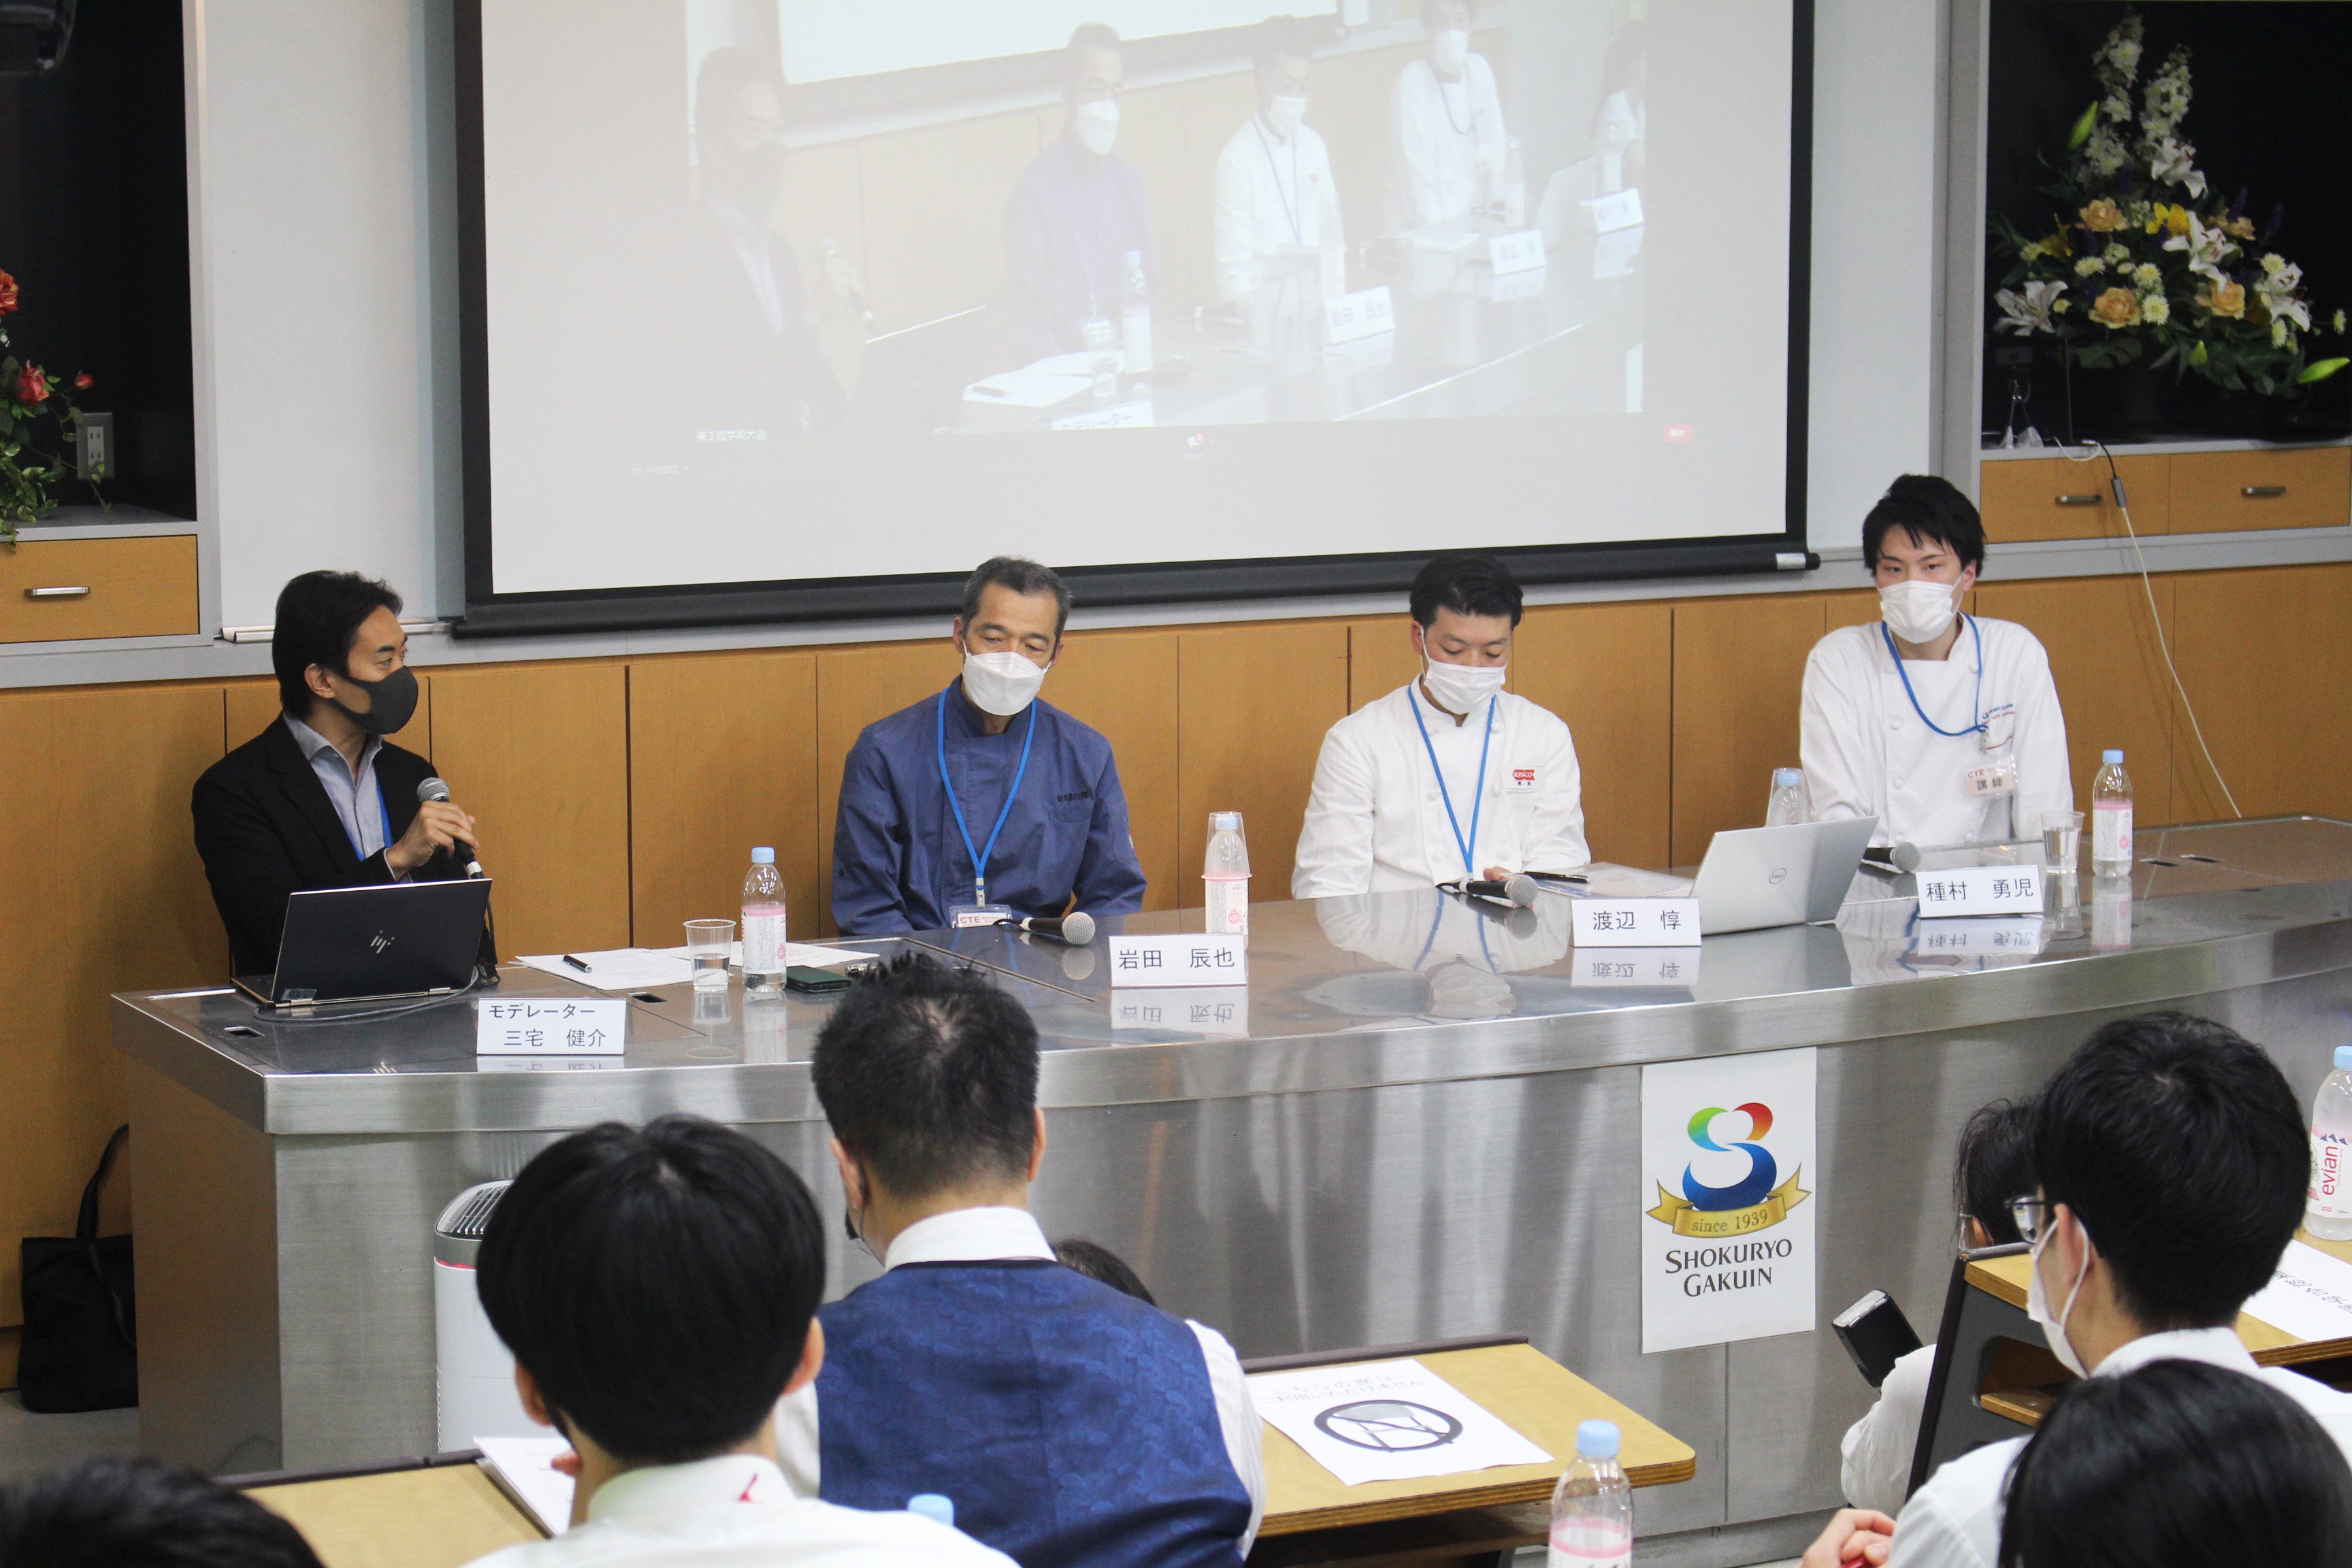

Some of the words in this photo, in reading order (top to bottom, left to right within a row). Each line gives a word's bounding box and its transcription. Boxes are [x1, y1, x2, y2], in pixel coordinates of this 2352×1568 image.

[1967, 768, 1986, 779] CTE
[1926, 881, 1967, 902] 種村
[1993, 878, 2034, 899] 勇児
[960, 915, 981, 924] CTE
[1593, 911, 1637, 930] 渡辺
[1660, 910, 1682, 930] 惇
[1118, 948, 1162, 970] 岩田
[1190, 947, 1235, 968] 辰也
[489, 1002, 595, 1019] モデレーター
[504, 1029, 544, 1047] 三宅
[566, 1029, 606, 1047] 健介
[2321, 1145, 2338, 1196] evian
[1692, 1218, 1728, 1232] since
[1735, 1209, 1768, 1230] 1939
[1665, 1239, 1793, 1274] SHOKURYO
[1683, 1267, 1772, 1297] GAKUIN
